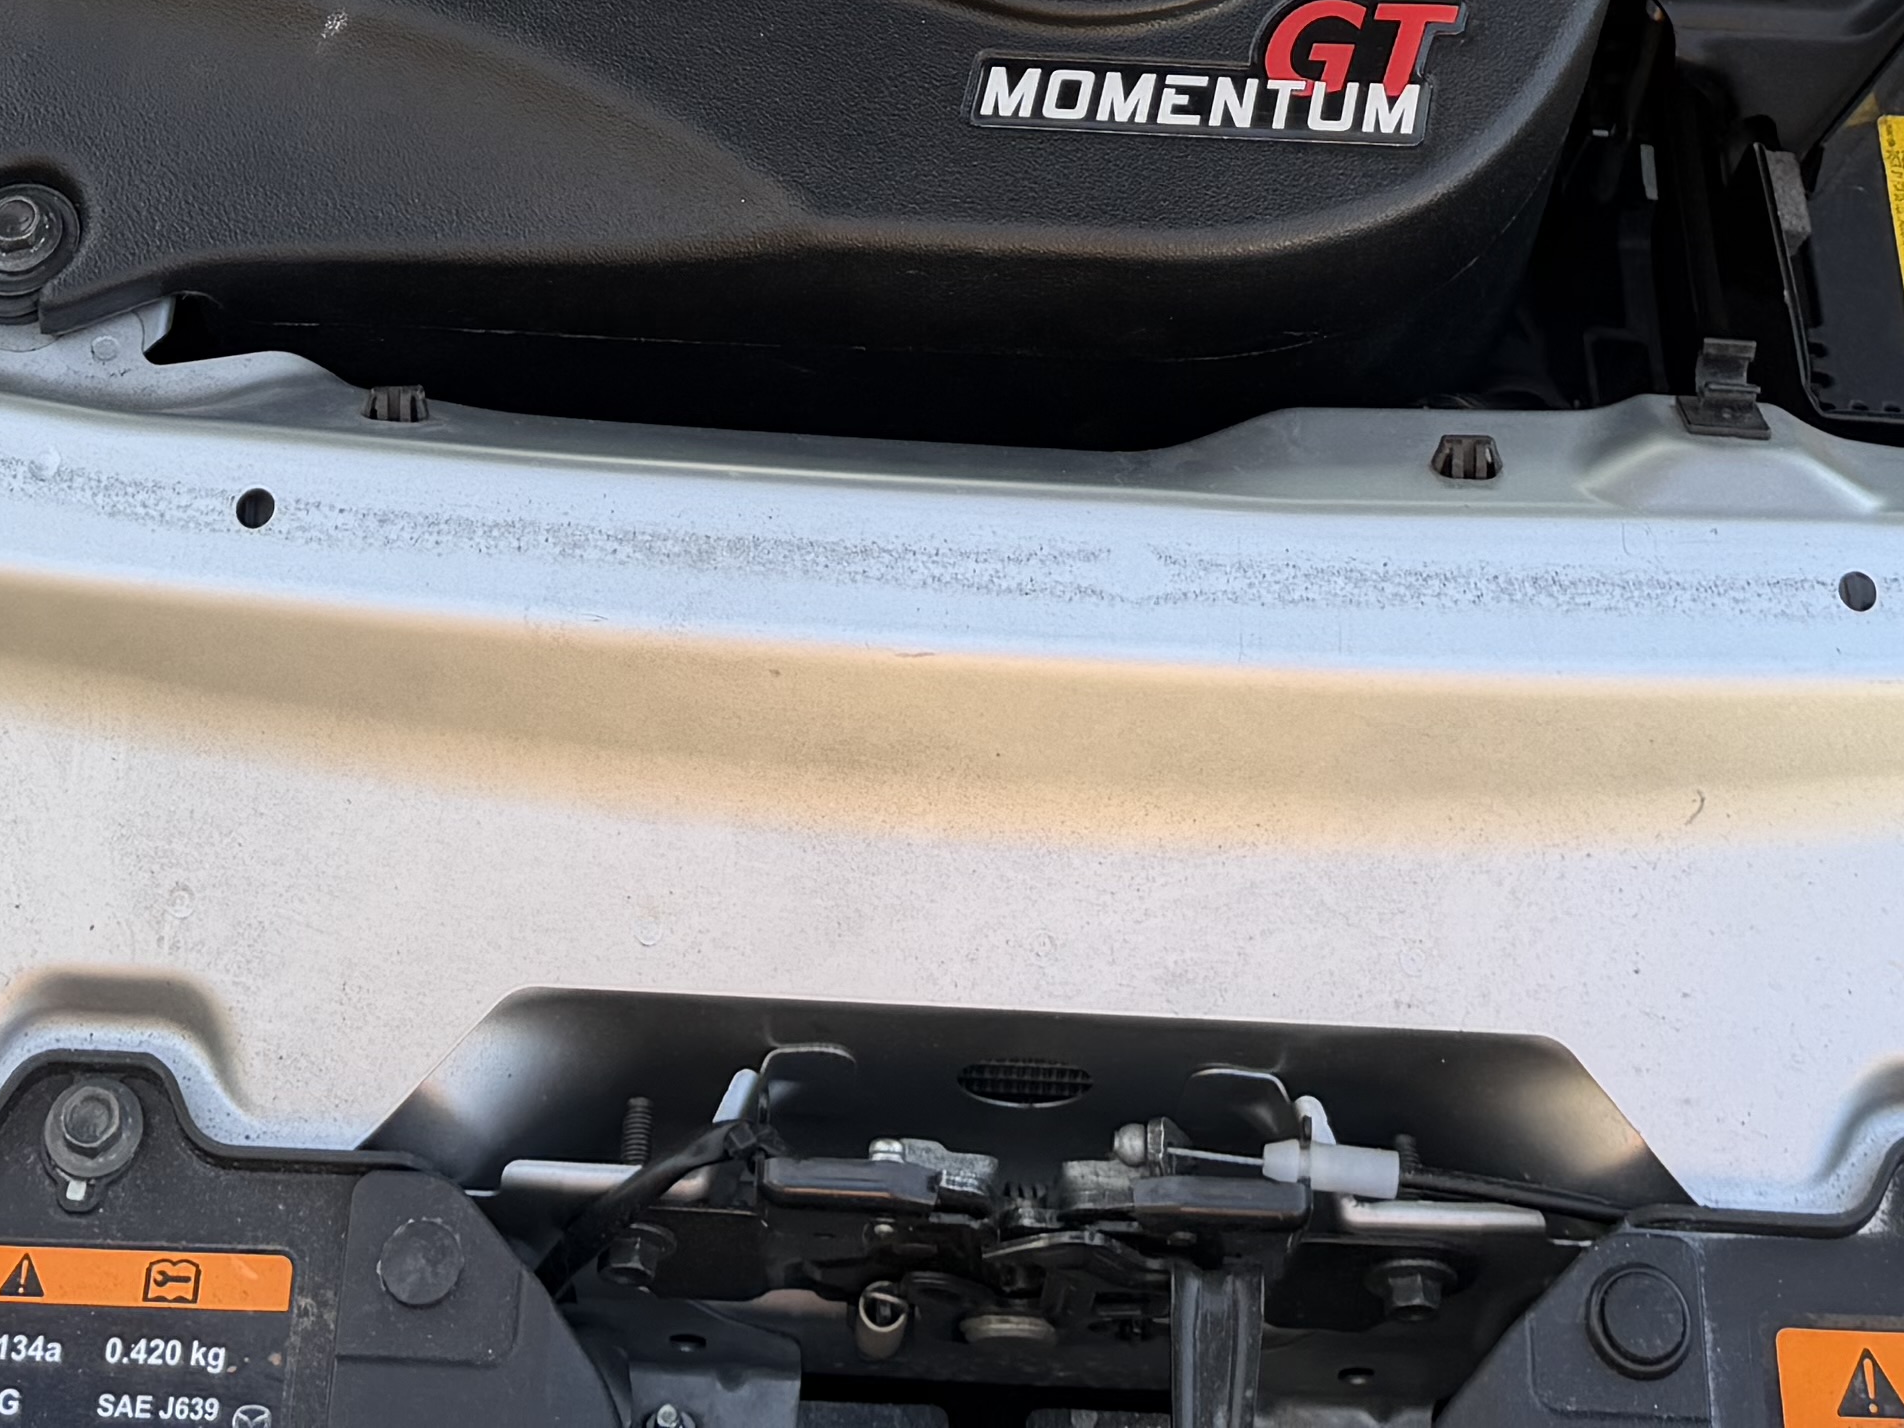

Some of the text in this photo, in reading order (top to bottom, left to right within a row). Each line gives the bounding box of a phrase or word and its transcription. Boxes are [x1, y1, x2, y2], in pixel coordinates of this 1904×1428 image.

[980, 65, 1420, 136] MOMENTUM
[105, 1336, 182, 1366] 0.420
[190, 1341, 226, 1374] kg
[97, 1393, 153, 1419] SAE
[159, 1396, 220, 1421] J639
